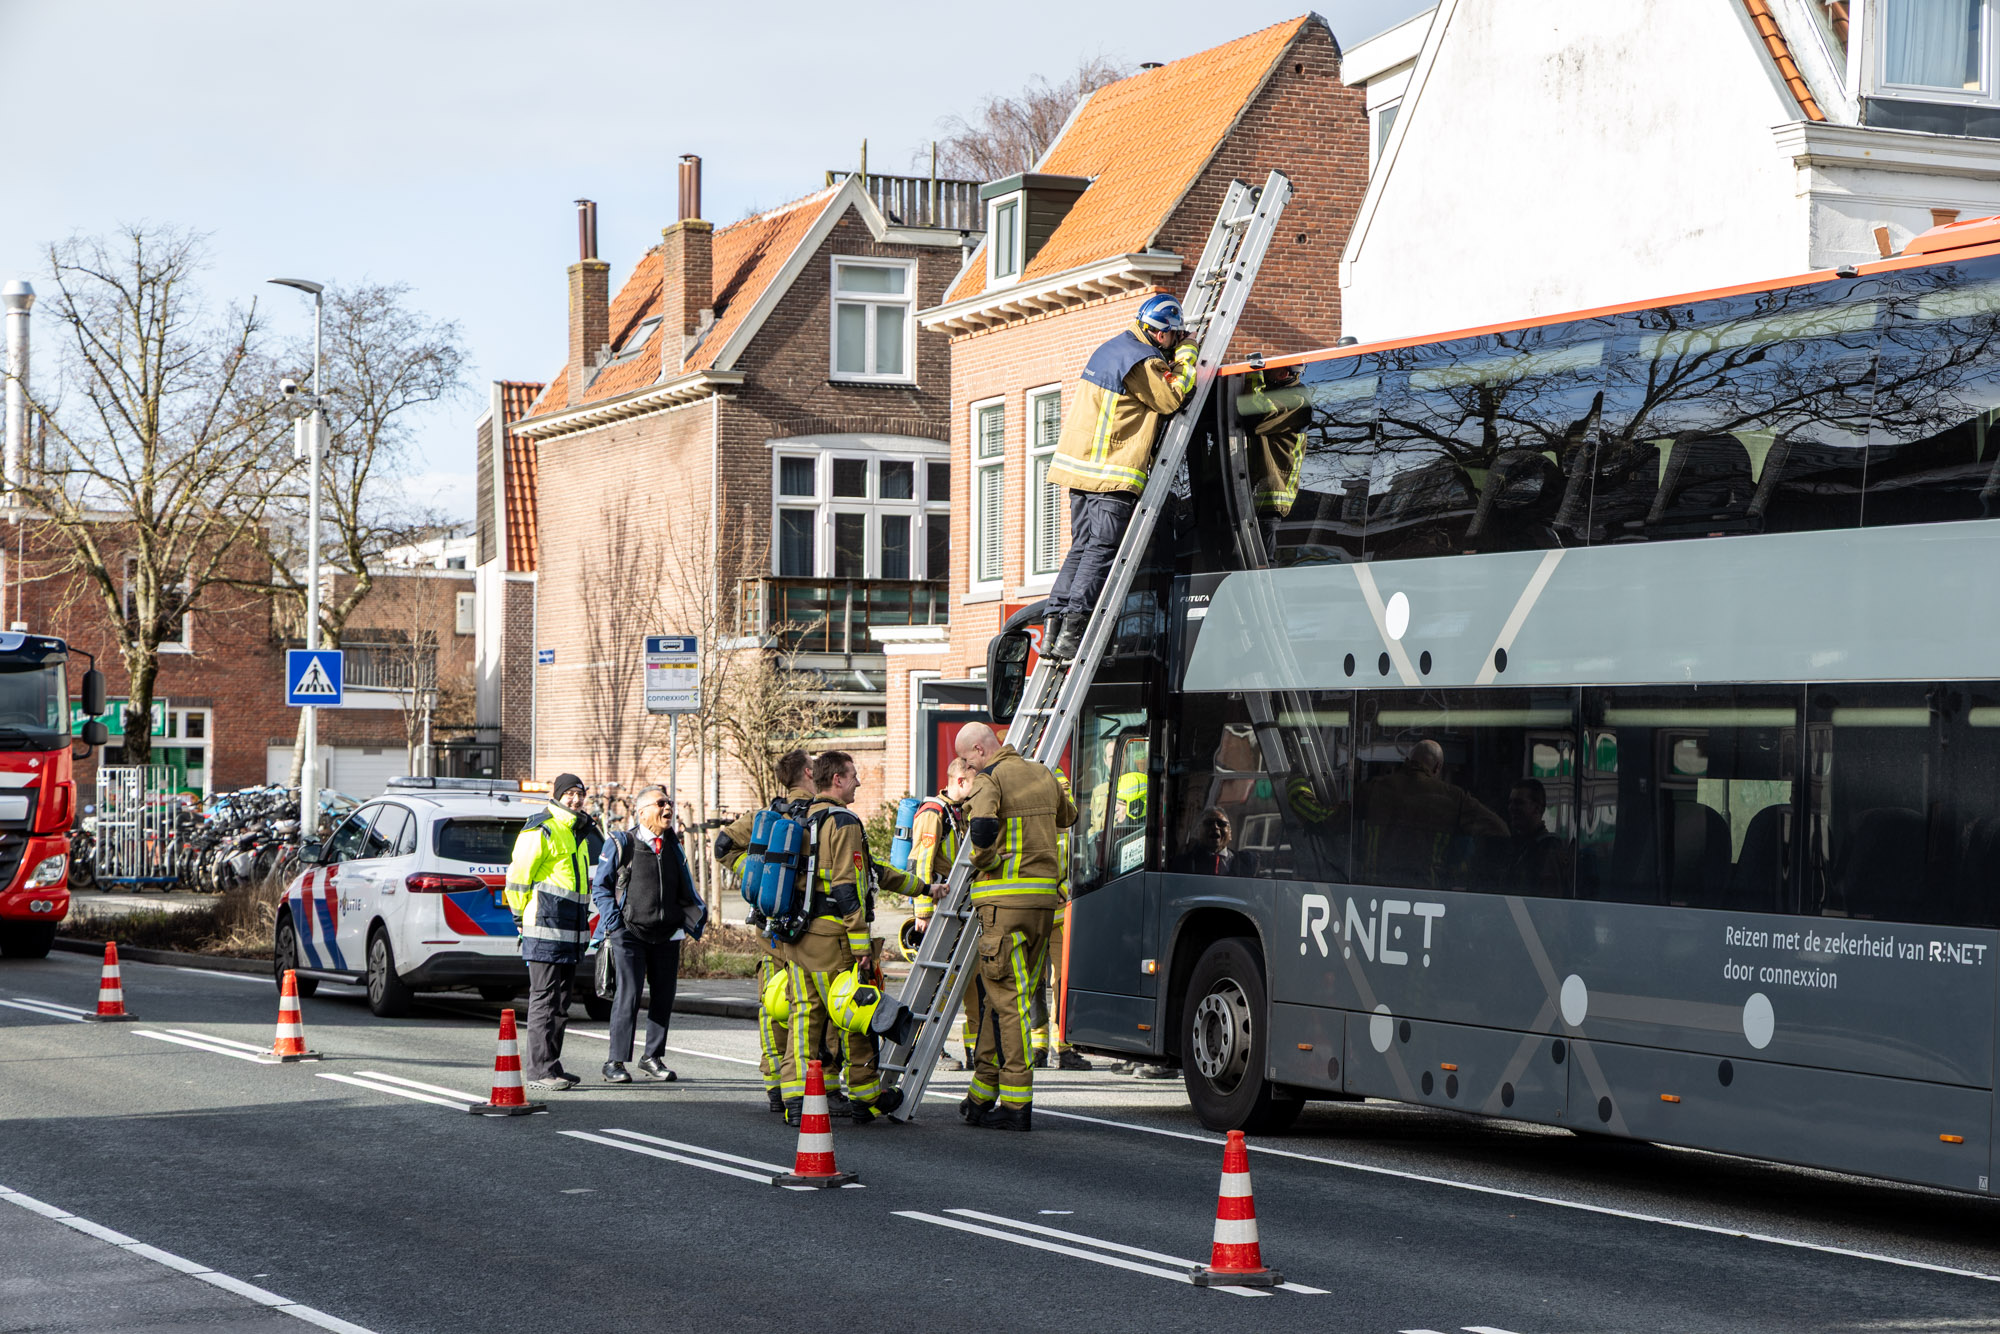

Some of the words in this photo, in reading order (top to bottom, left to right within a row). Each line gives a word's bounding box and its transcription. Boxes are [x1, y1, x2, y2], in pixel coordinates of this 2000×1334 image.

[647, 694, 690, 702] connexxion
[1725, 925, 1769, 948] Reizen
[1772, 932, 1801, 950] met
[1804, 929, 1821, 952] de
[1824, 931, 1894, 958] zekerheid
[1898, 942, 1925, 961] van
[1723, 957, 1755, 981] door
[1759, 966, 1838, 989] connexxion
